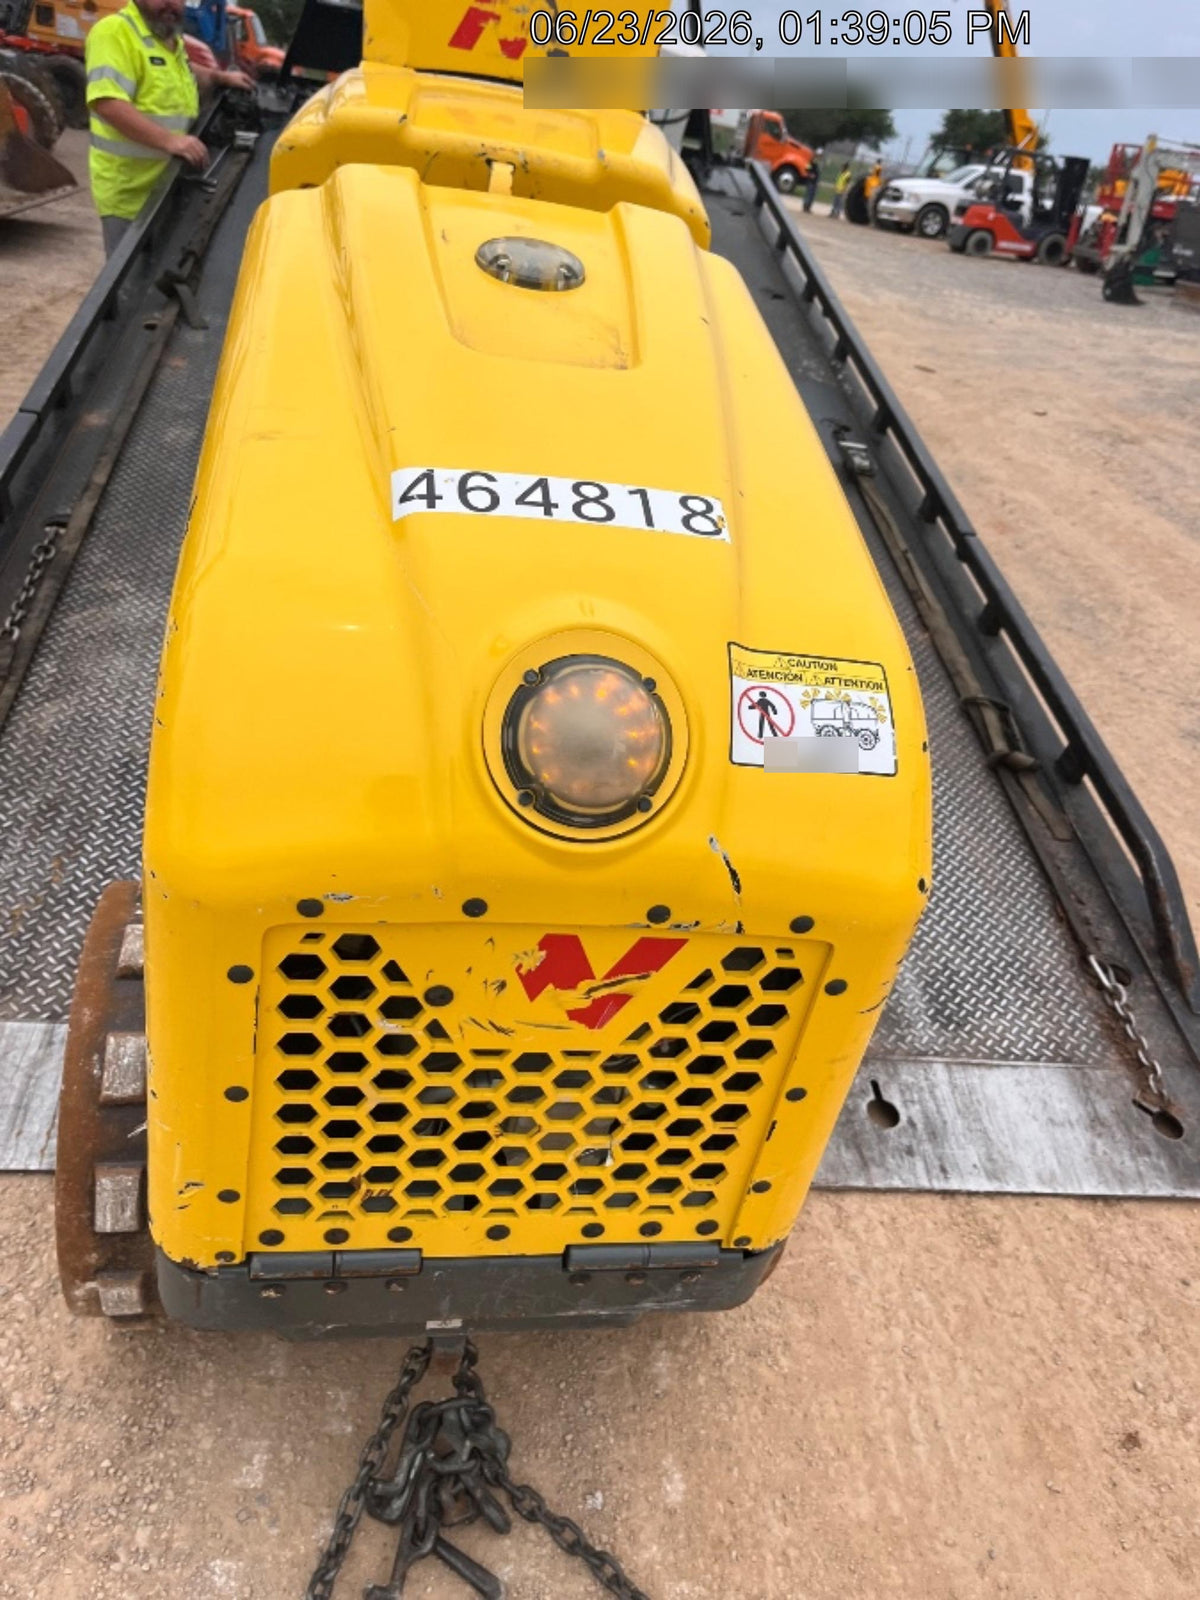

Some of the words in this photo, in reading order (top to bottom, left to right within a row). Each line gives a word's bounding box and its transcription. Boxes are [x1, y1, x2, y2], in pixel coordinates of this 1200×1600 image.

[399, 468, 724, 537] 464818
[787, 658, 838, 671] CAUTION
[824, 676, 884, 690] ATTENTION
